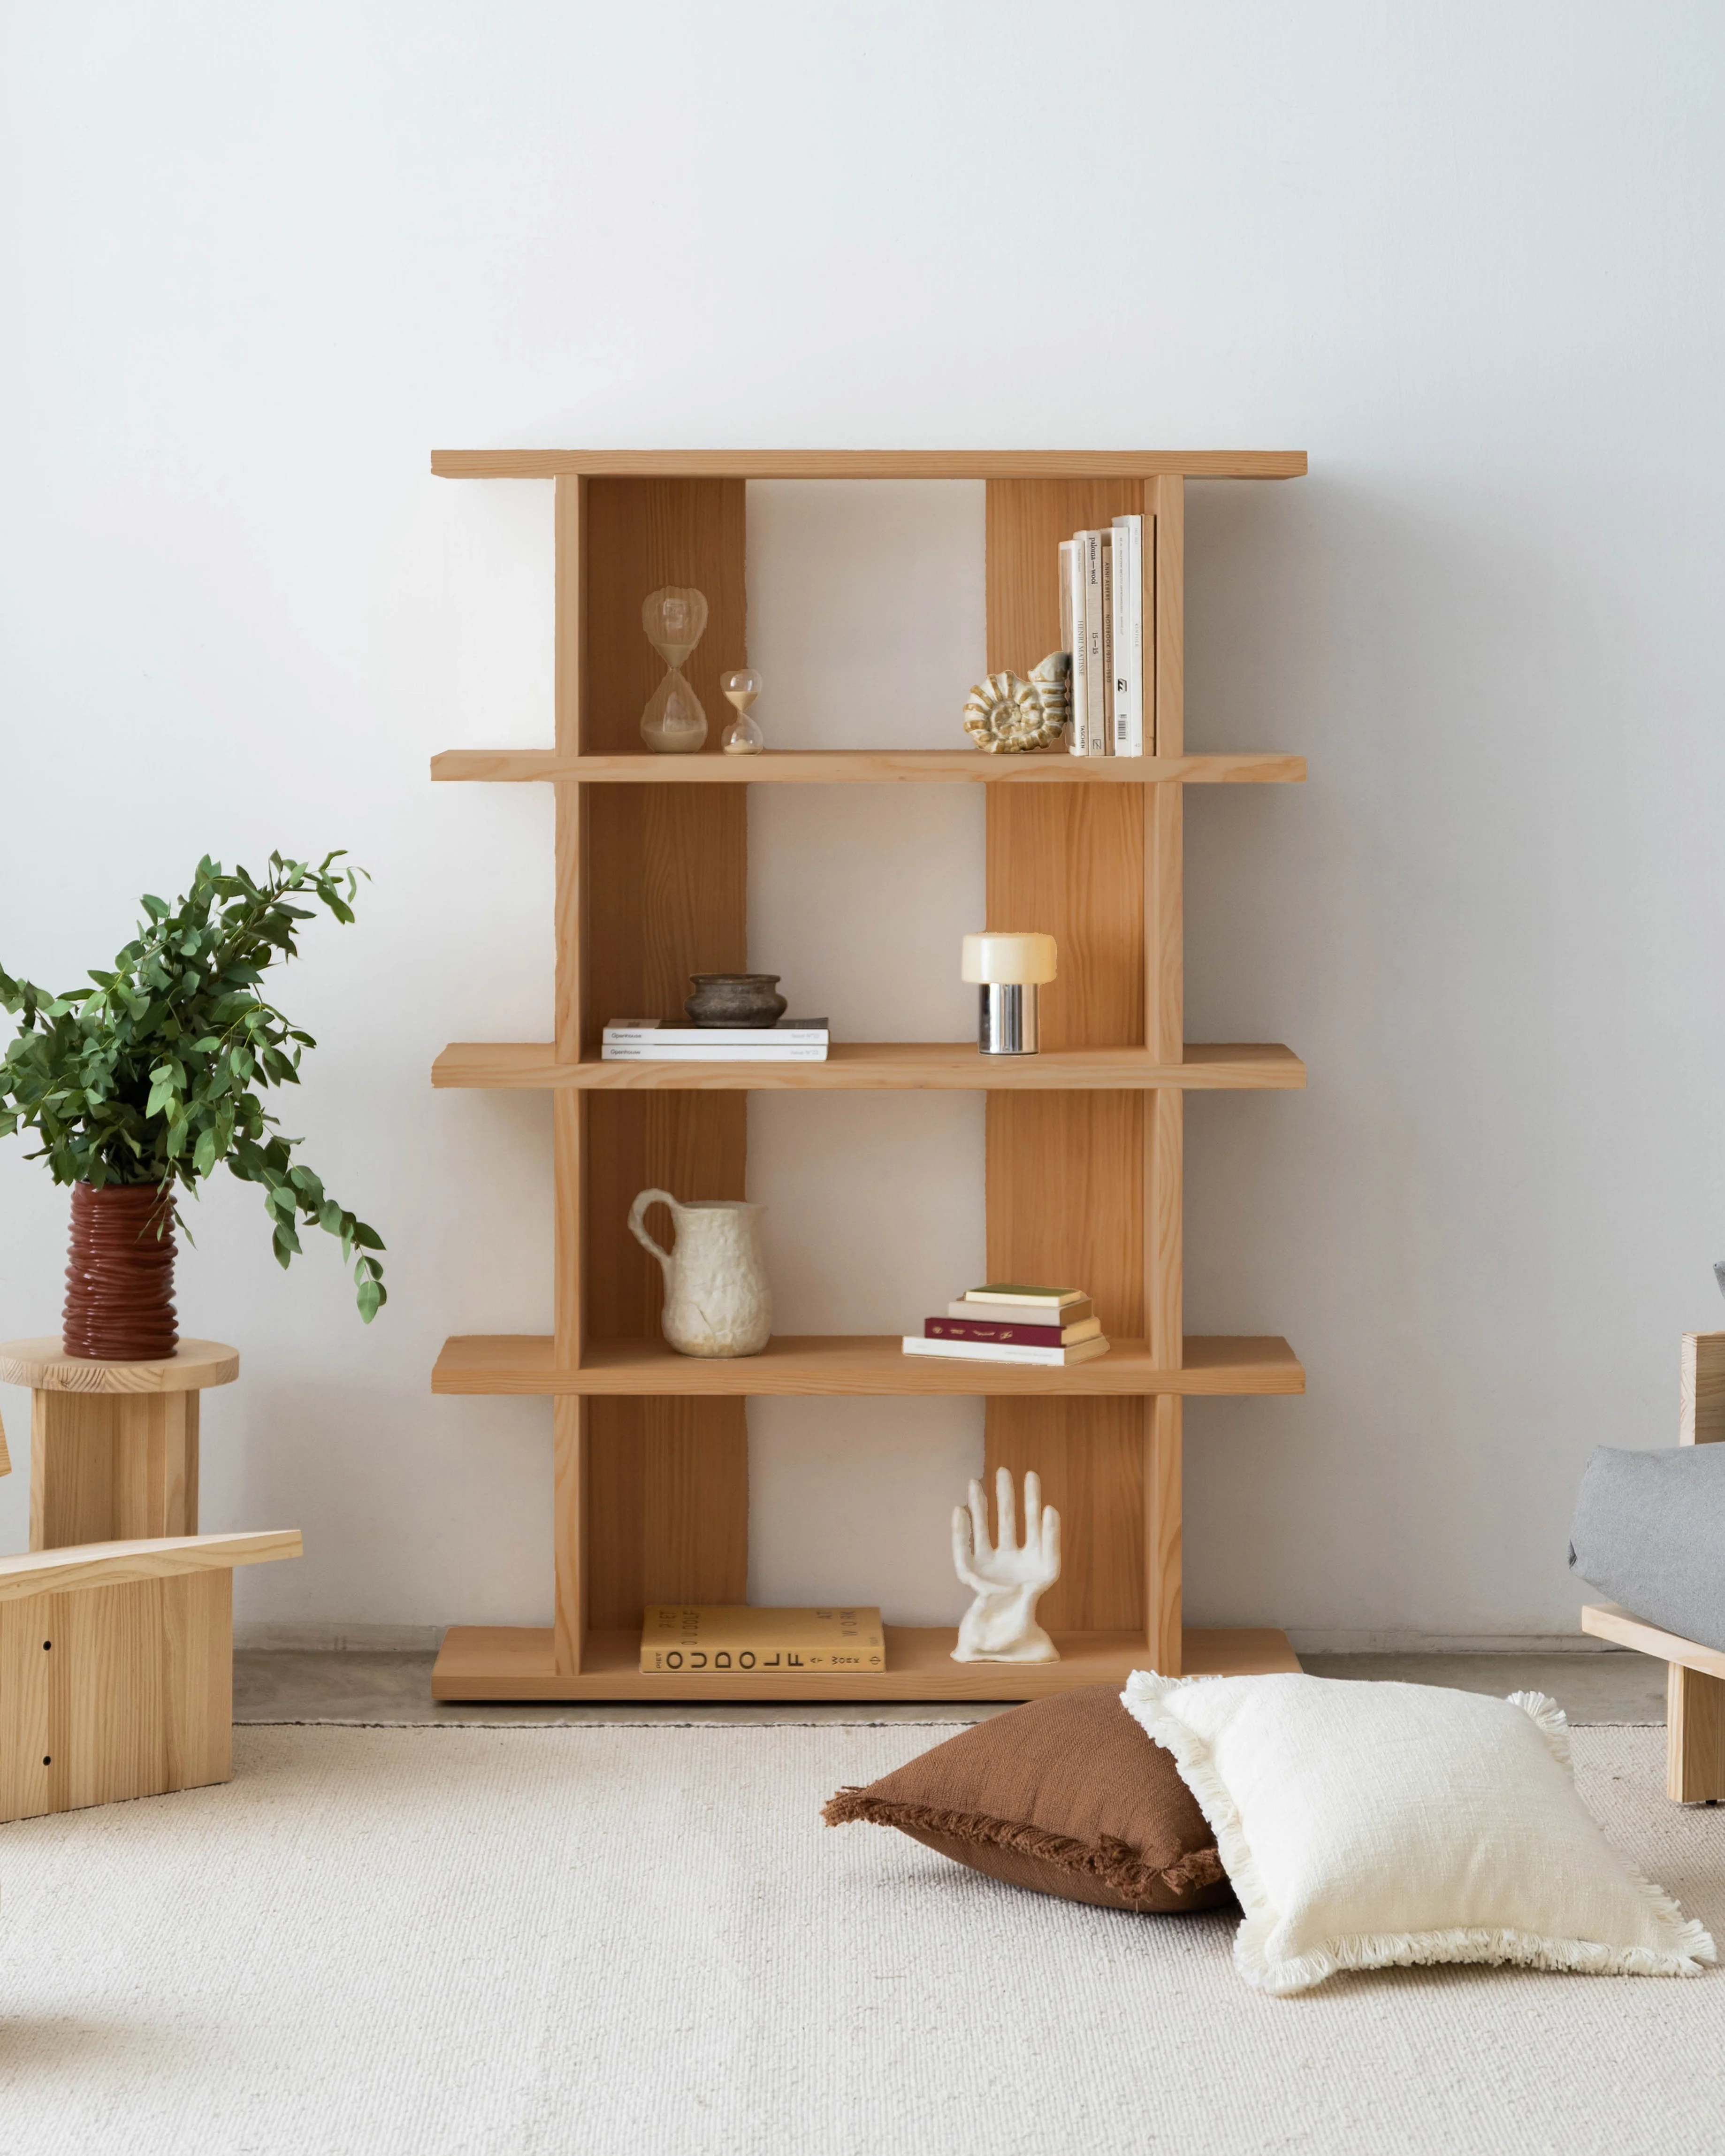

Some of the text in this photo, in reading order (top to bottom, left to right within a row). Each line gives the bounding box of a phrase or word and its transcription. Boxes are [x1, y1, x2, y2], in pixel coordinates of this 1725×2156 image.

[659, 1611, 676, 1628] PIET
[816, 1611, 832, 1620] AT
[840, 1611, 858, 1637] WORK
[681, 1610, 700, 1645] OUDOLF
[666, 1651, 804, 1669] OUDOLF
[832, 1656, 860, 1665] WORK
